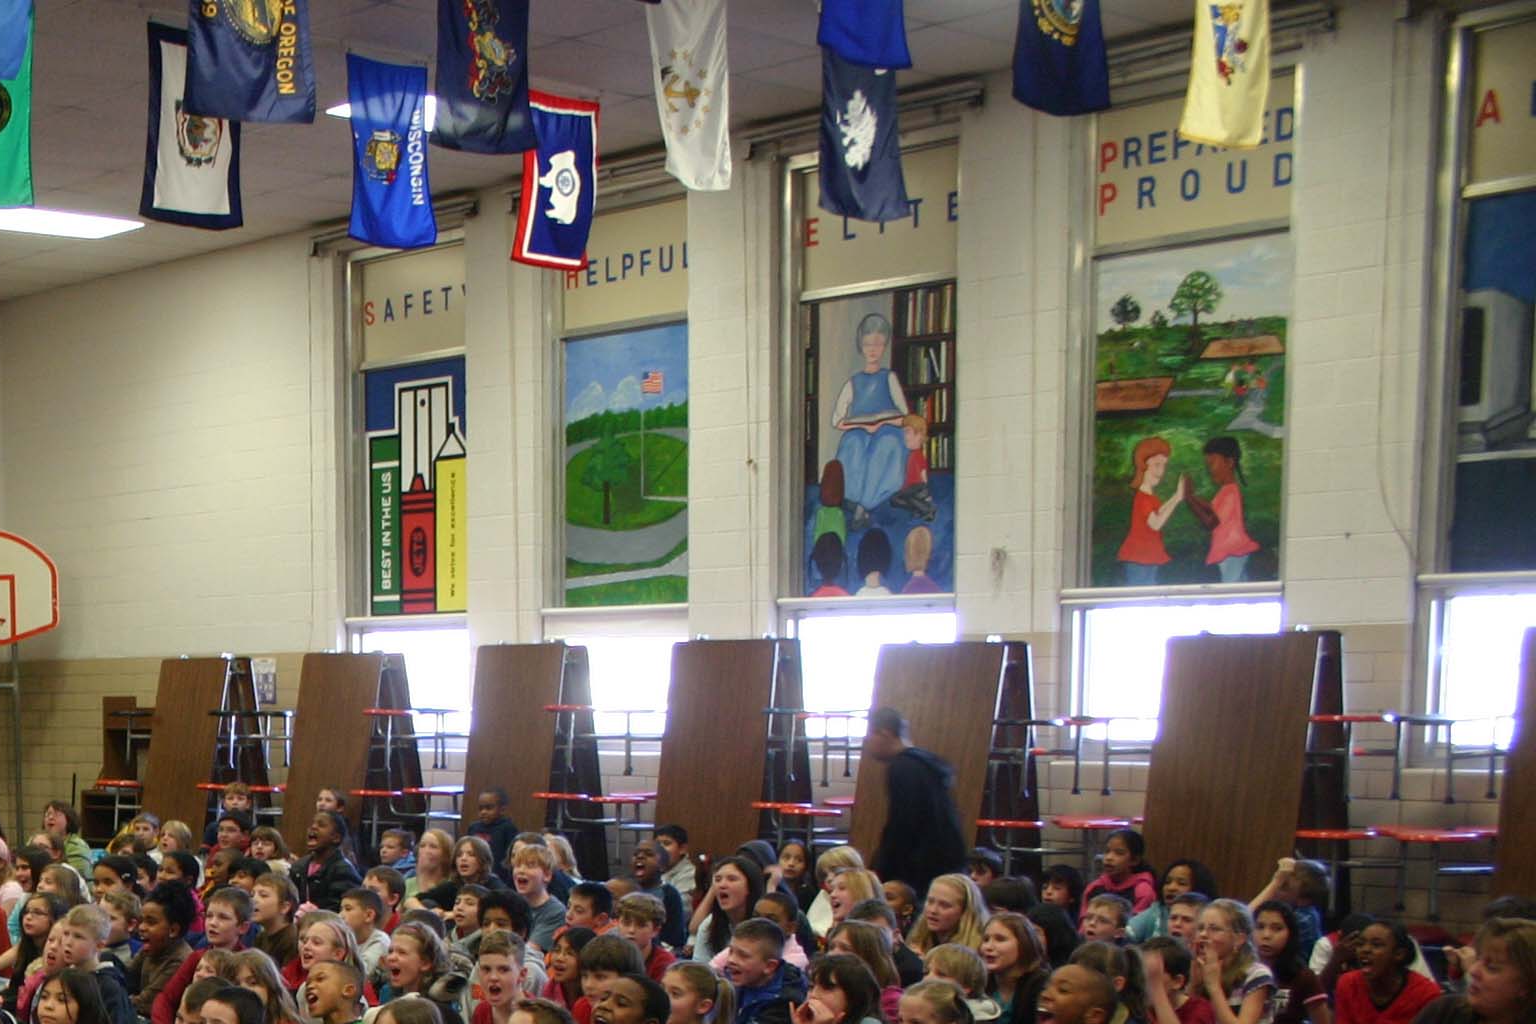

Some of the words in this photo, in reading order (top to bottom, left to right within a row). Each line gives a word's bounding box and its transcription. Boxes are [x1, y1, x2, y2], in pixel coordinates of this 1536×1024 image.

[276, 22, 297, 94] OREGON
[1099, 106, 1294, 173] PREPD
[1098, 152, 1293, 217] PROUD
[381, 471, 392, 494] US
[381, 496, 392, 530] THE
[381, 531, 392, 547] IN
[380, 550, 392, 590] BEST
